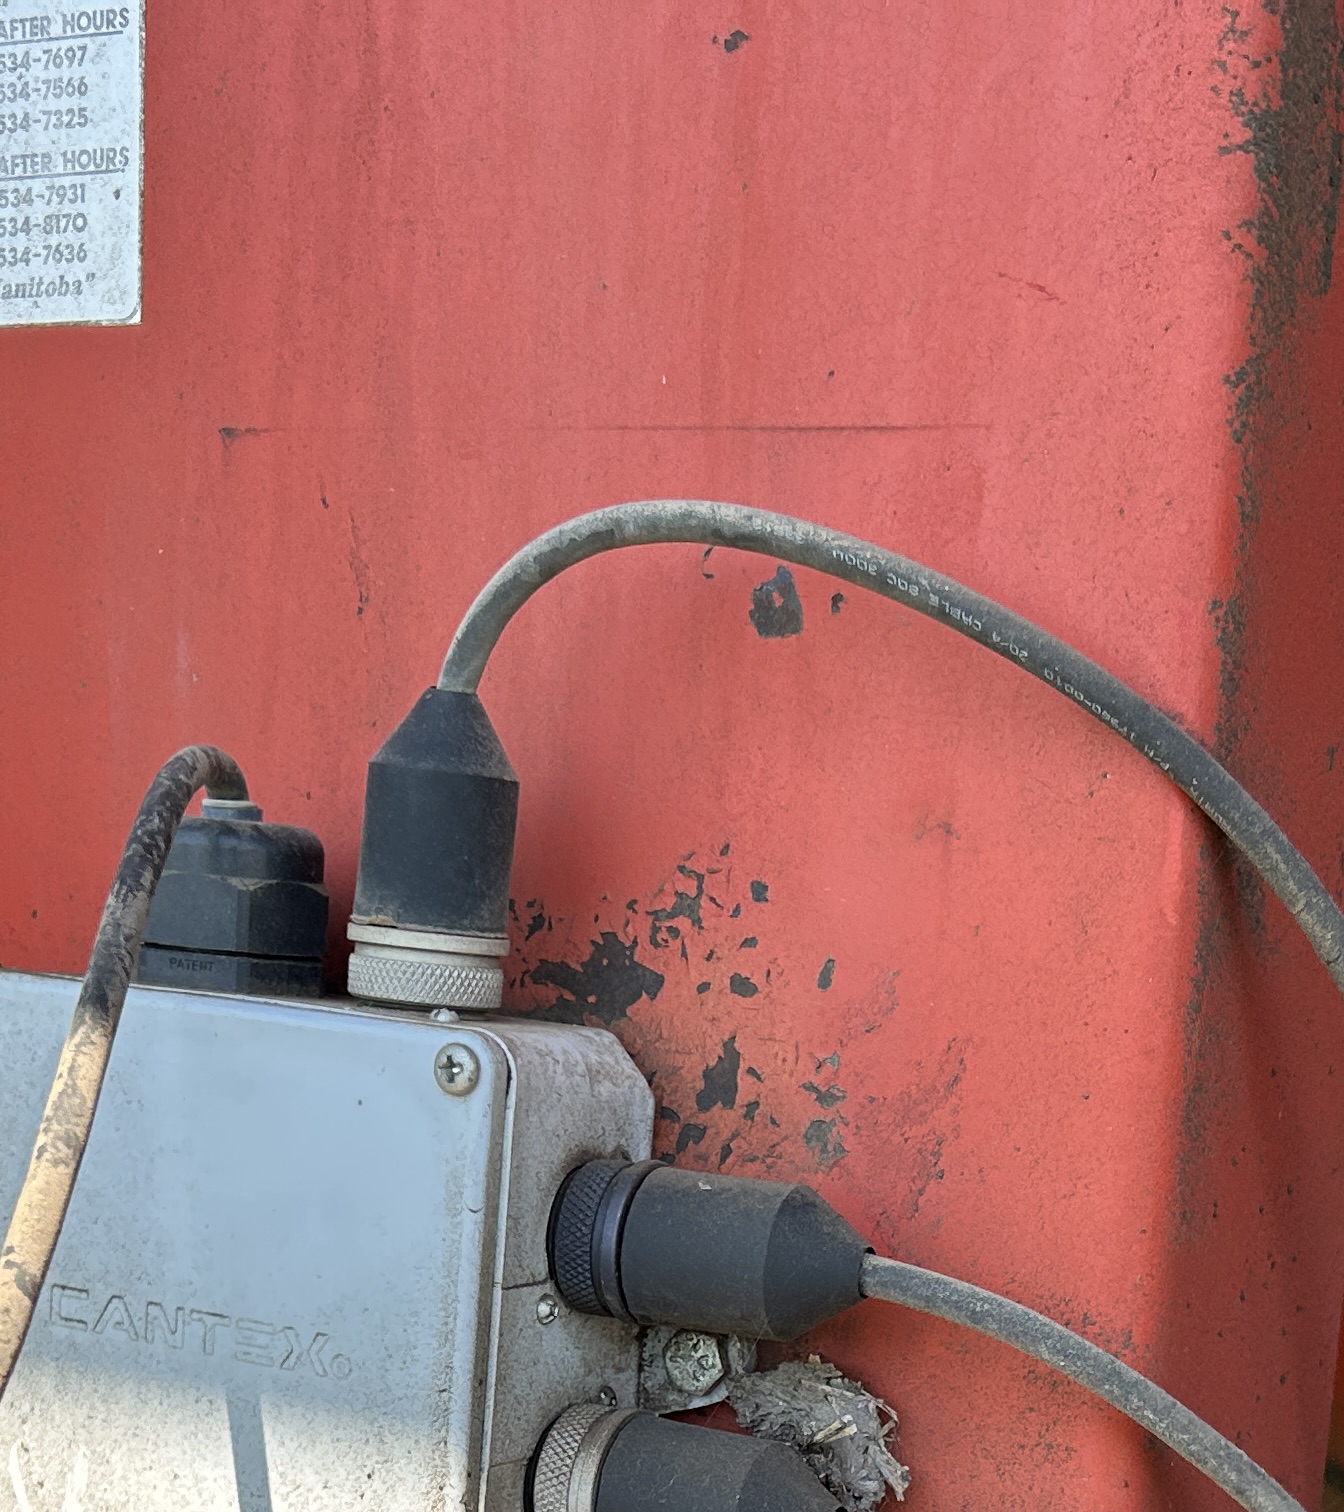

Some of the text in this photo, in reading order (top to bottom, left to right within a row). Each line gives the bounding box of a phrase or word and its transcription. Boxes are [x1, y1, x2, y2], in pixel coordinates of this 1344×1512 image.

[62, 8, 130, 33] HOURS
[61, 147, 130, 171] HOURS
[928, 592, 982, 632] CABLE
[168, 956, 215, 972] PATENT
[51, 1284, 330, 1379] CANTEX
